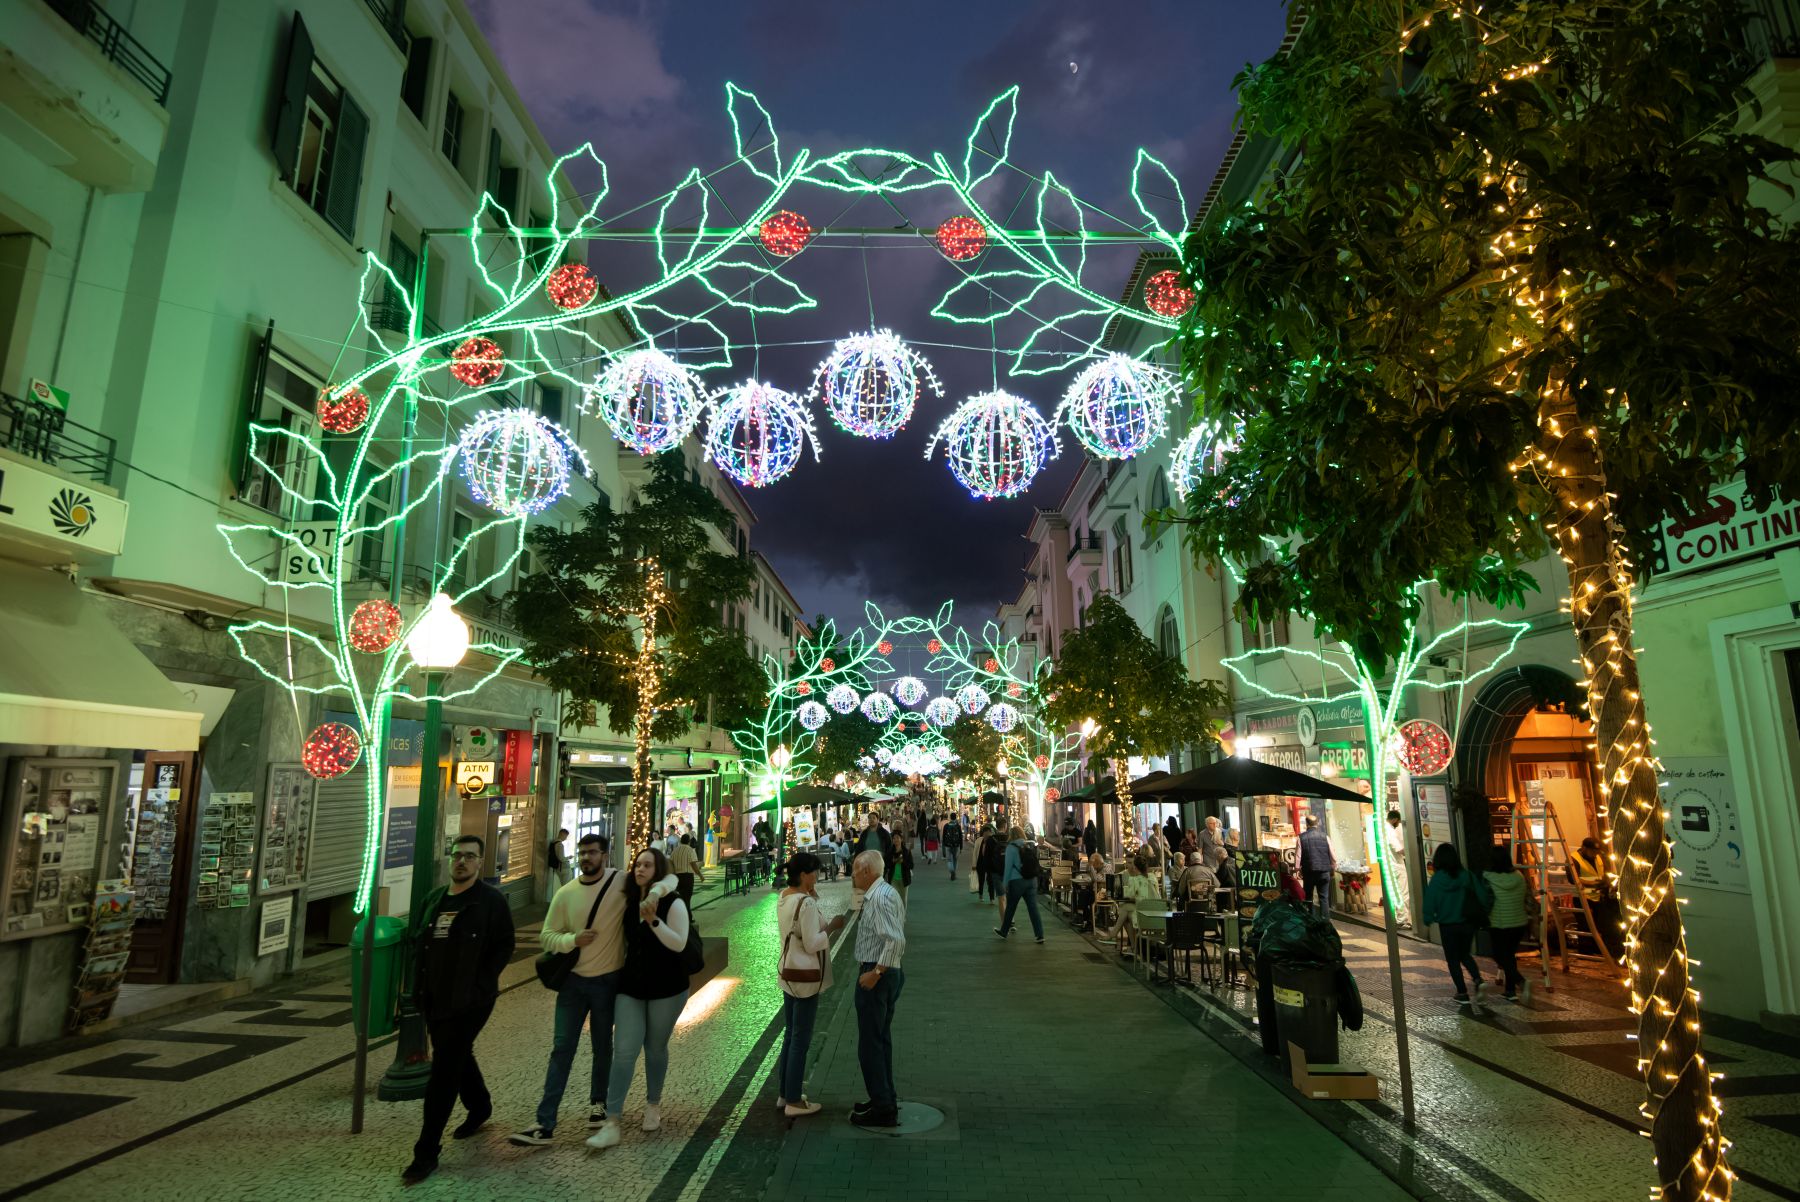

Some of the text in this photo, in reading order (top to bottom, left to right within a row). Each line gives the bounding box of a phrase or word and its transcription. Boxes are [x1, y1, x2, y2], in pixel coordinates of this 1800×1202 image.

[468, 624, 514, 654] OTOSOL
[506, 732, 516, 794] LOTARIAS
[1240, 869, 1277, 888] PIZZAS
